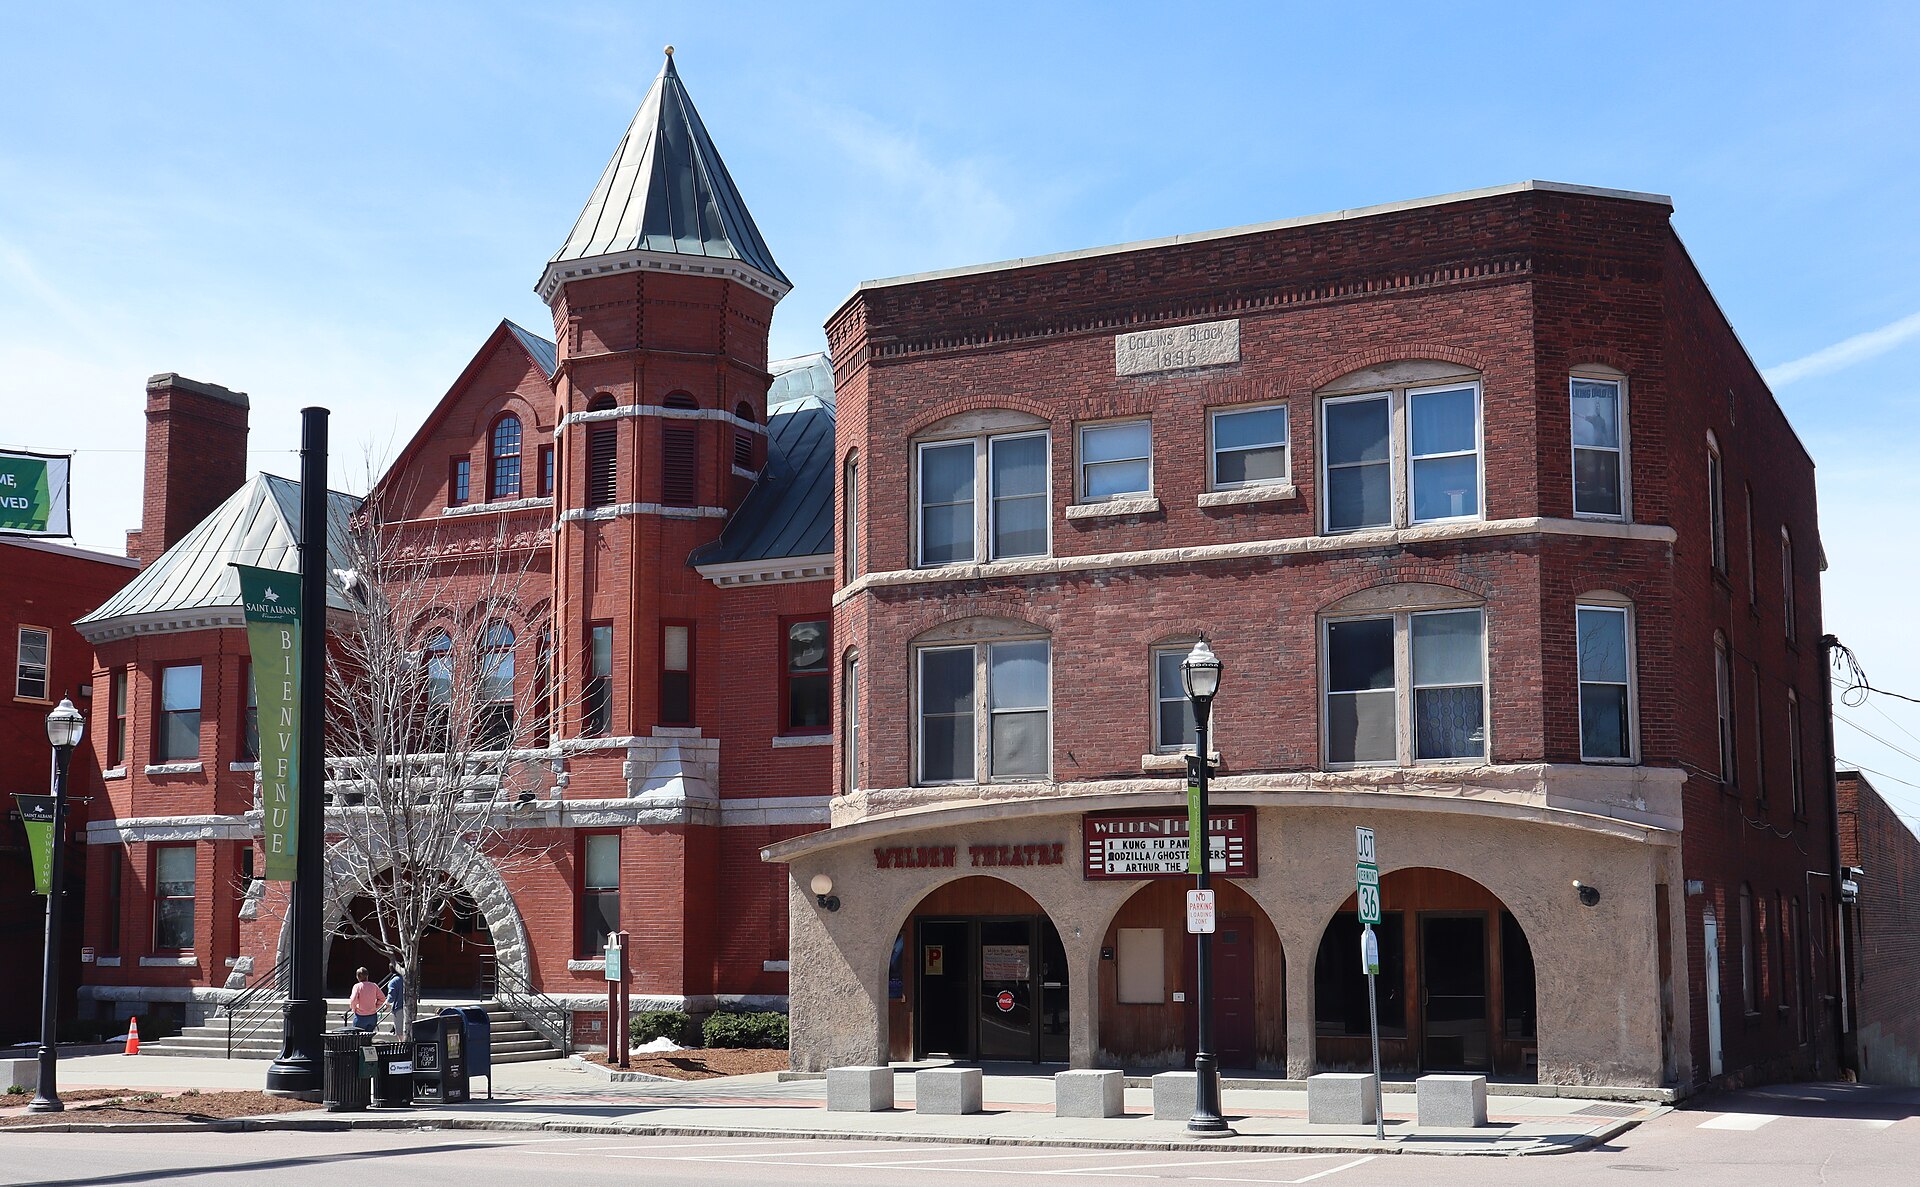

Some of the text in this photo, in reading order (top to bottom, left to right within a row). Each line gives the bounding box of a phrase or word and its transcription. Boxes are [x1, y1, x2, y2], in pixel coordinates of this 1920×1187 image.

[246, 603, 297, 615] SAINT ALBANS
[271, 630, 292, 853] BIENVENUE
[1094, 821, 1160, 834] WELDEN
[1122, 840, 1146, 850] KUNG
[1153, 839, 1165, 849] FU
[1358, 834, 1374, 857] JCT
[42, 825, 52, 884] DOWNTOWN
[874, 843, 1065, 868] WELDEN THEATRE
[1108, 863, 1115, 873] 3
[1125, 862, 1160, 872] ARTHUR
[1166, 861, 1181, 871] THE
[1358, 869, 1377, 882] VERMONT
[1195, 893, 1206, 901] NO
[1362, 887, 1377, 918] 36
[1190, 902, 1212, 910] PARKING
